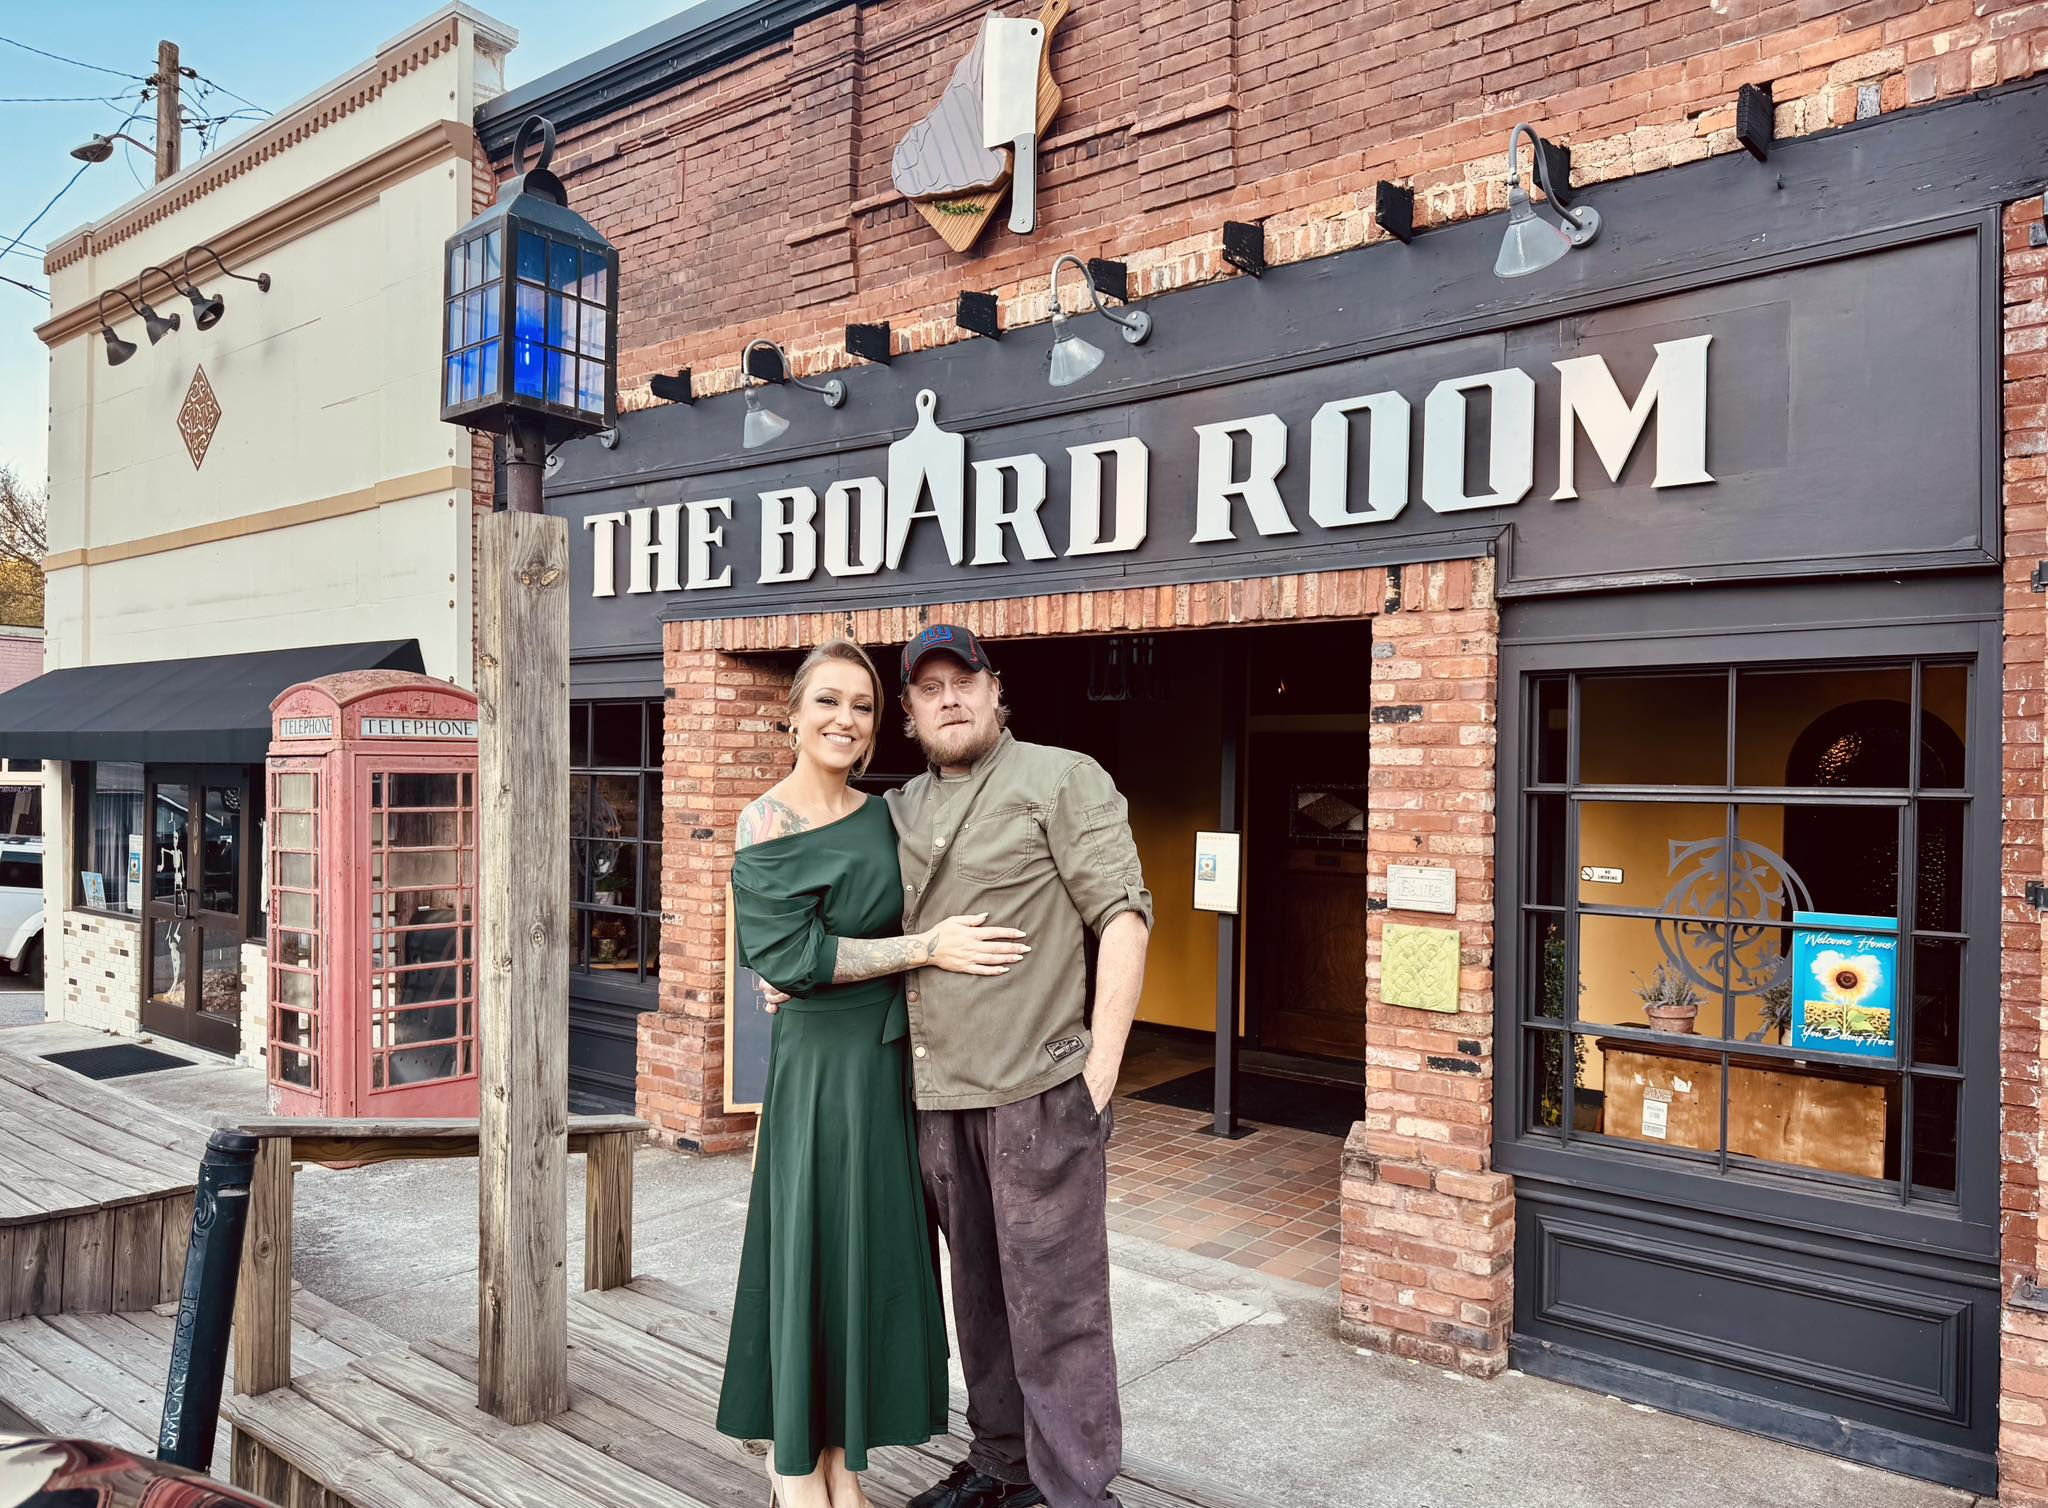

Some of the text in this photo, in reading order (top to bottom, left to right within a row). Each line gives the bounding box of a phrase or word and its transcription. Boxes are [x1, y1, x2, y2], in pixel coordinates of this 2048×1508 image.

[584, 333, 1717, 597] THE BOARD ROOM
[283, 718, 333, 736] TELEPHONE
[363, 719, 473, 736] TELEPHONE
[1799, 931, 1897, 951] Welcome Home!
[1797, 1024, 1895, 1048] You Belong Here
[178, 1288, 199, 1340] POLE
